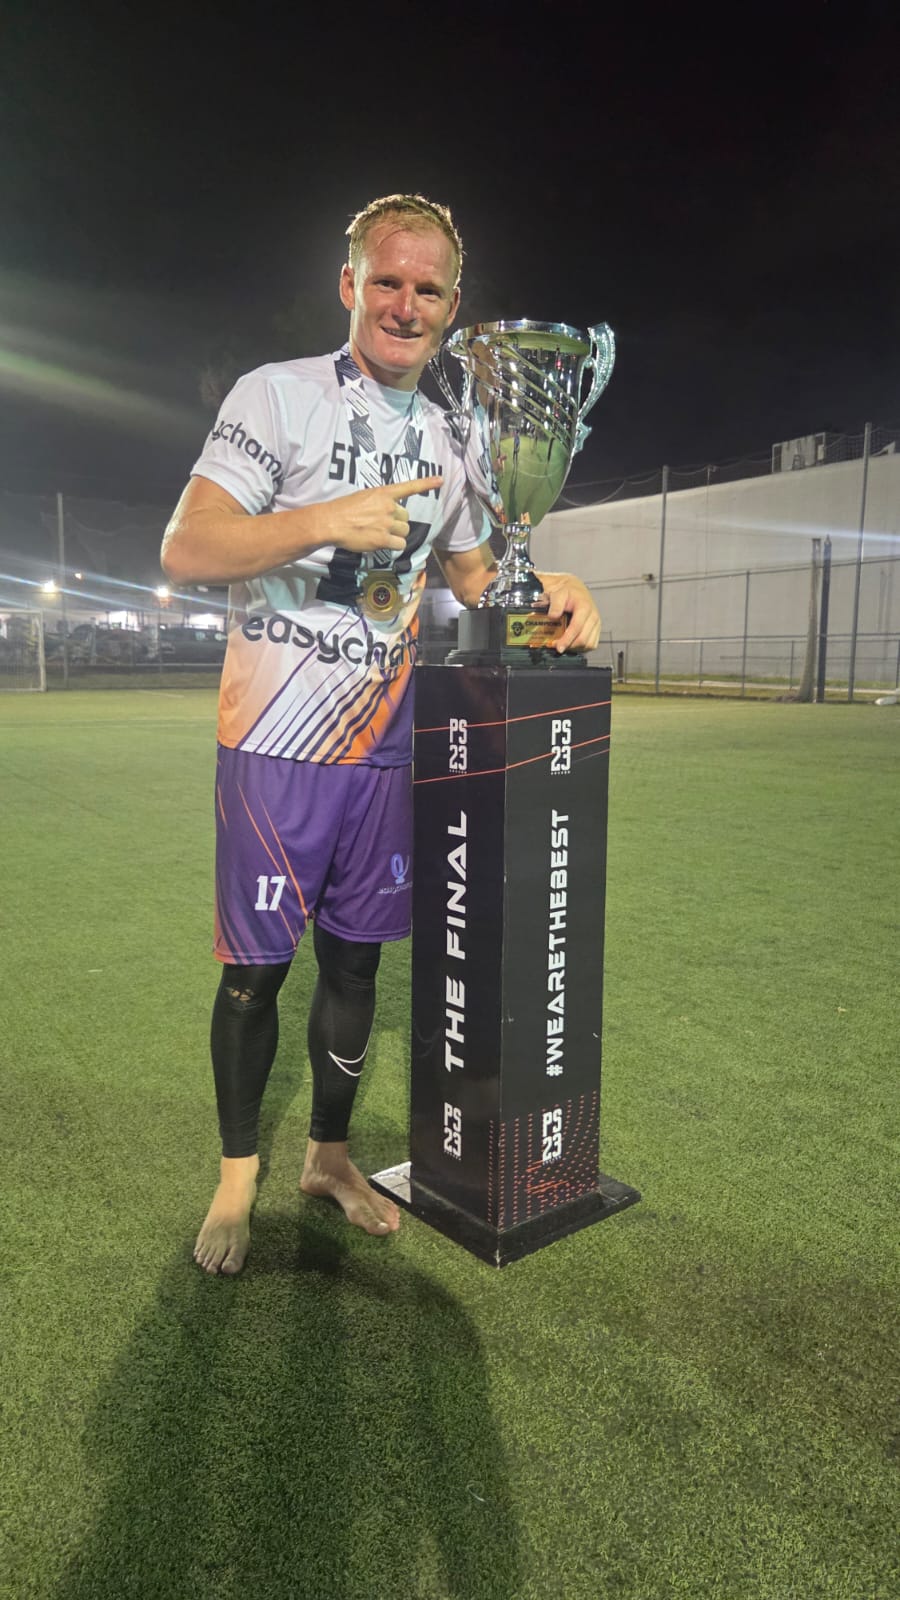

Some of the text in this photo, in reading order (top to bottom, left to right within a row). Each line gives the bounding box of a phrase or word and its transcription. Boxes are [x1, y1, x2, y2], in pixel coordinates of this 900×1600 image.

[449, 718, 468, 745] PS
[551, 719, 572, 745] PS
[448, 744, 468, 771] 23
[550, 746, 571, 772] 23
[254, 875, 287, 911] 17
[444, 810, 468, 1073] THE FINAL
[546, 809, 569, 1077] #WEARETHEBEST
[443, 1102, 462, 1131] PS
[542, 1108, 563, 1136] PS
[443, 1126, 462, 1157] 23
[541, 1133, 563, 1162] 23
